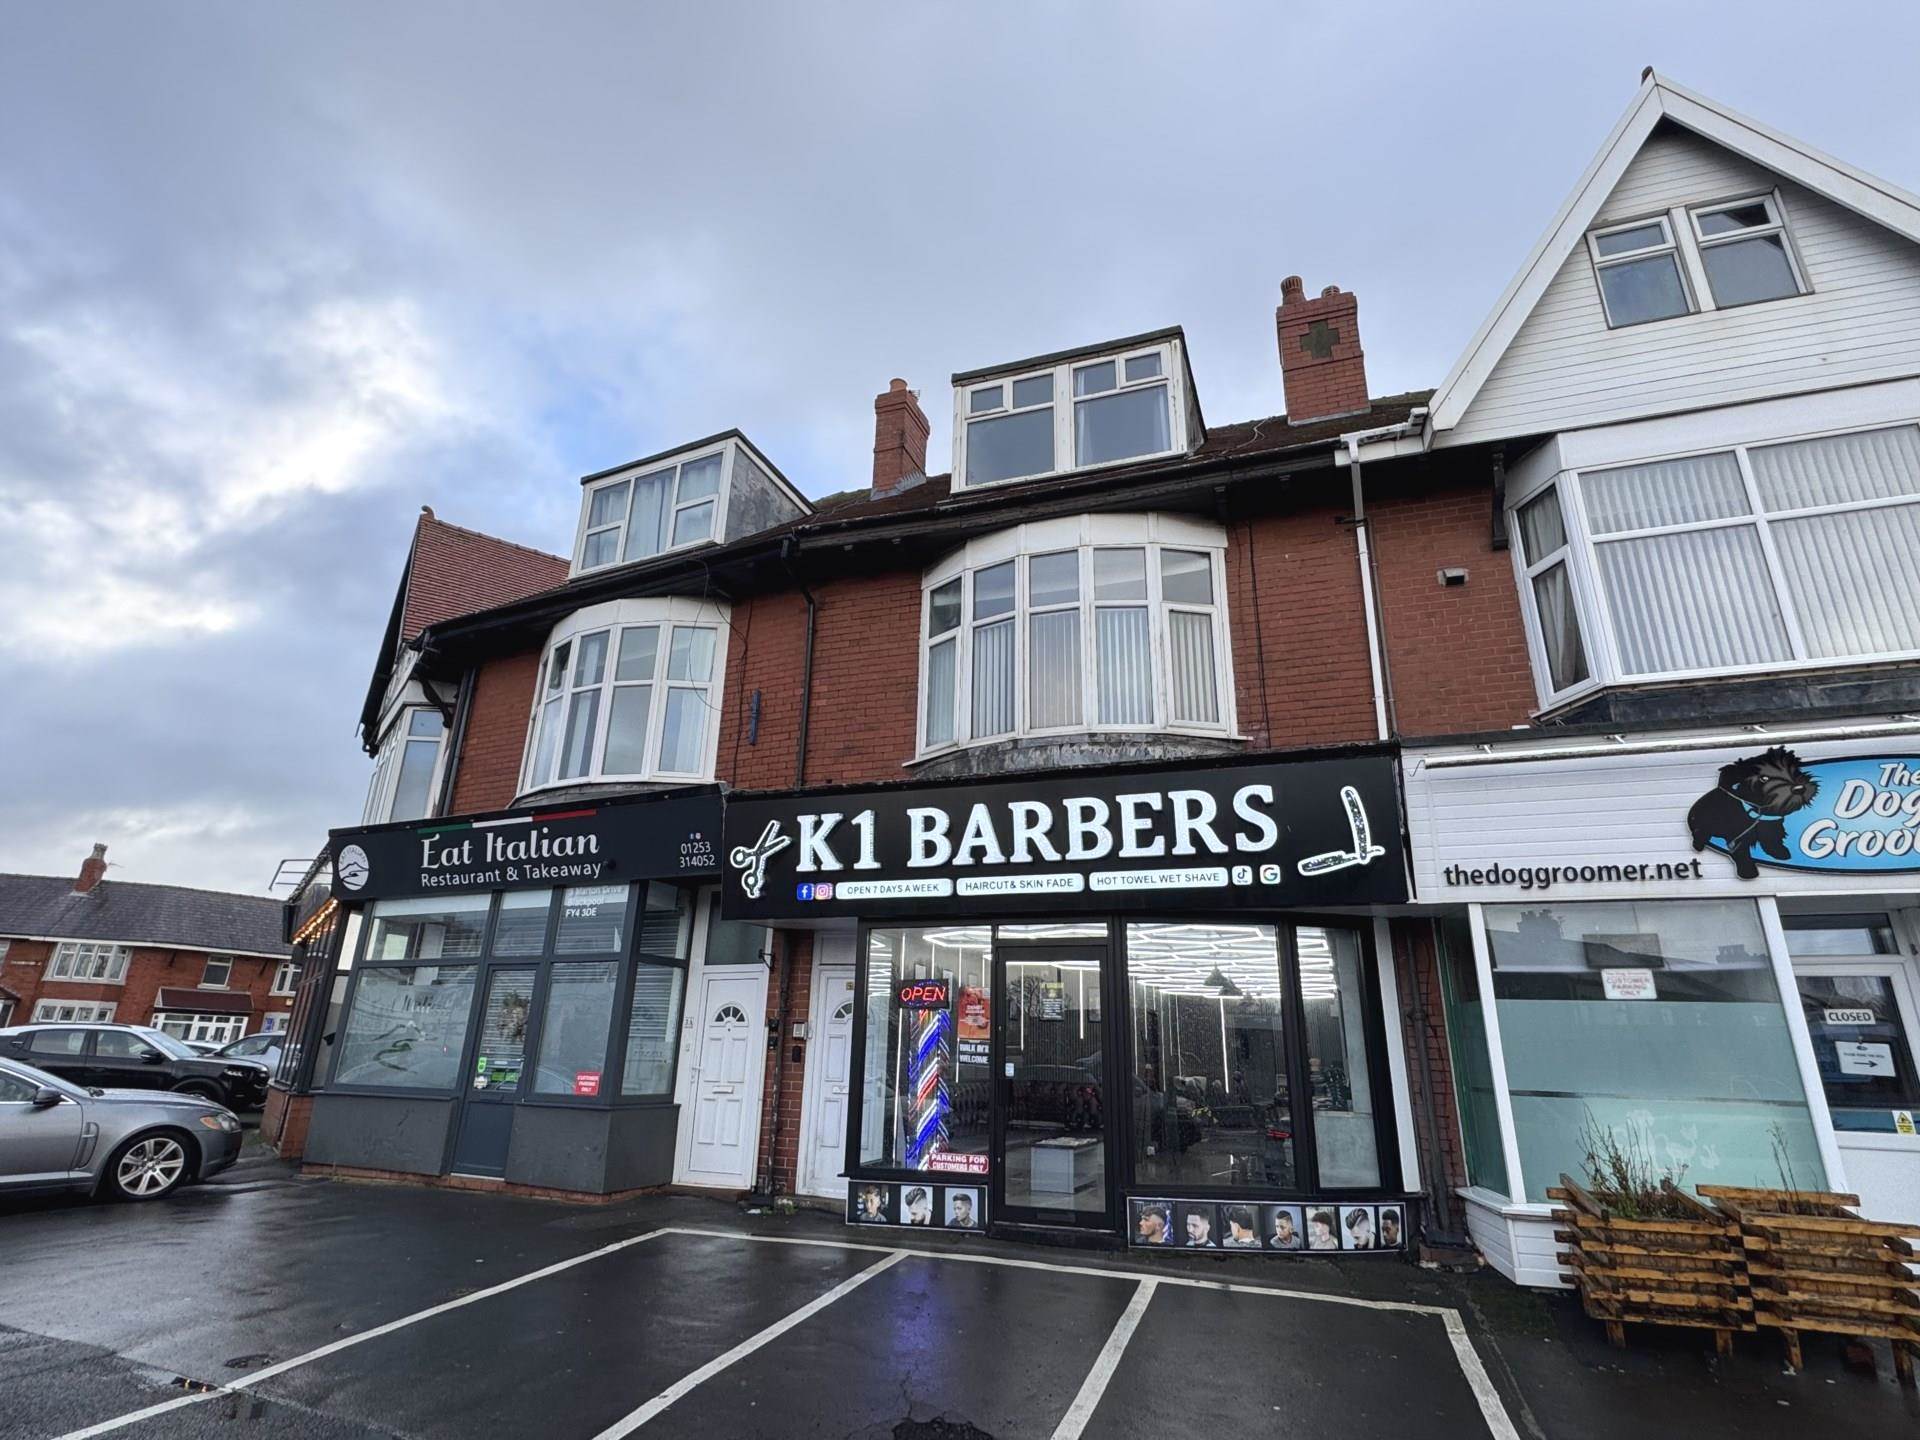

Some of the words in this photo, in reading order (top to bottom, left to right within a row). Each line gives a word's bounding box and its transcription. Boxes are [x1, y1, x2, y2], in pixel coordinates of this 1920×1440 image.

[1880, 762, 1920, 788] The
[1834, 779, 1920, 828] Dog
[796, 810, 882, 872] K1
[907, 784, 1278, 868] BARBERS
[1800, 818, 1920, 859] Groo
[421, 833, 473, 869] Eat
[486, 827, 600, 863] Italian
[680, 841, 711, 855] 01253
[680, 854, 716, 868] 314052
[421, 870, 501, 887] Restaurant
[506, 867, 519, 881] &
[523, 863, 601, 880] Takeaway
[1097, 876, 1118, 885] HOT
[1121, 875, 1157, 884] TOWEL
[1159, 874, 1181, 883] WET
[1185, 873, 1221, 882] SHAVE
[1444, 858, 1703, 889] thedoggroomer.net
[847, 885, 871, 895] OPEN
[873, 885, 878, 894] 7
[880, 884, 903, 894] DAYS
[904, 884, 911, 892] A
[912, 883, 940, 892] WEEK
[1019, 879, 1043, 889] SKIN
[1047, 878, 1074, 887] FADE
[565, 908, 580, 918] FY4
[901, 986, 946, 1002] OPEN
[1828, 1011, 1872, 1022] CLOSED
[959, 1054, 989, 1064] WELCOME
[931, 1153, 967, 1163] PARKING
[968, 1155, 986, 1164] FOR
[932, 1161, 968, 1171] CUSTOMERS
[968, 1164, 984, 1172] ONLY
